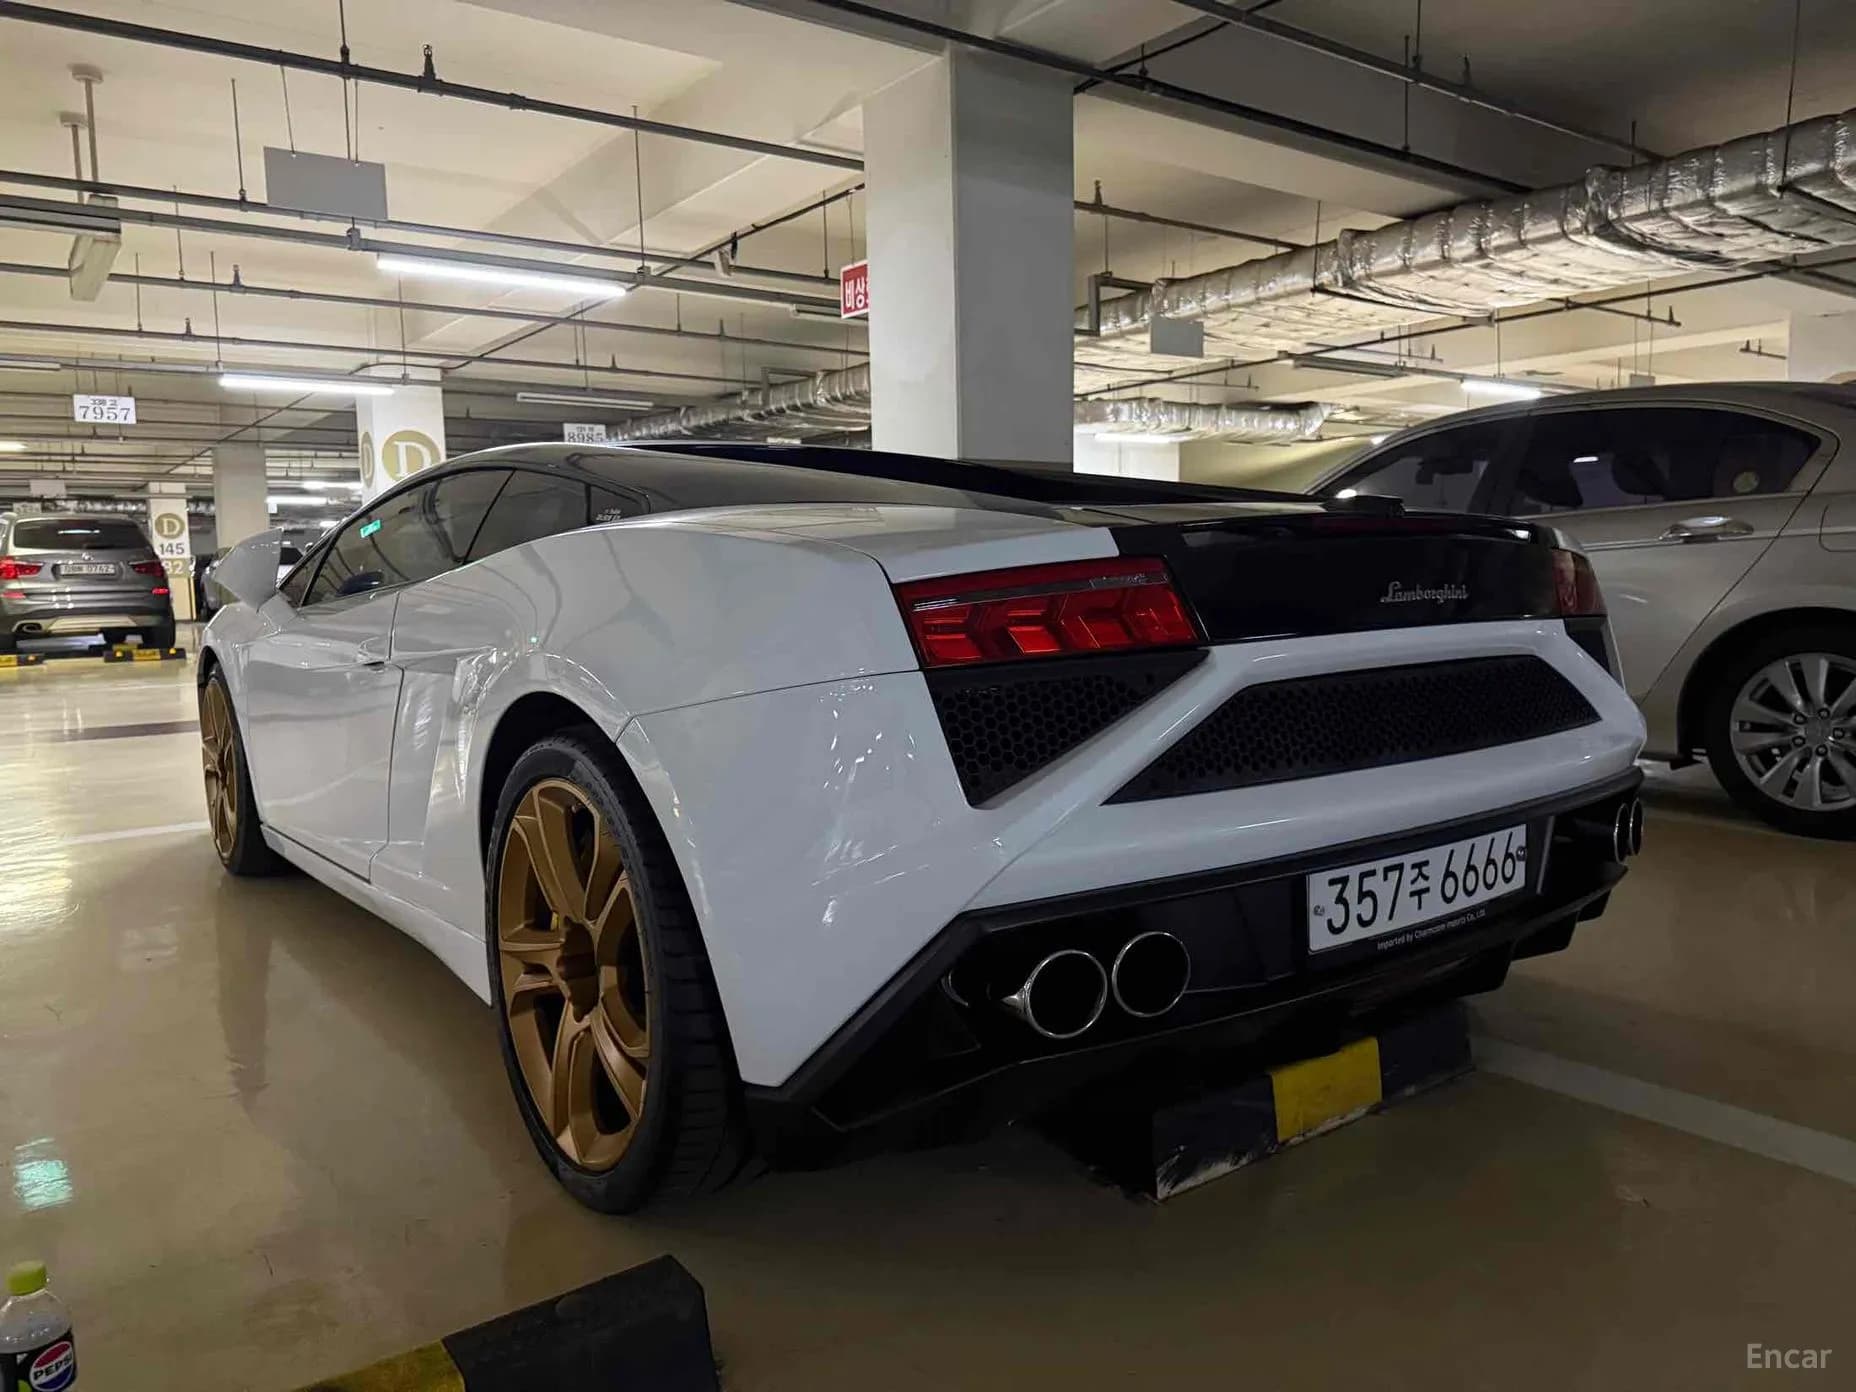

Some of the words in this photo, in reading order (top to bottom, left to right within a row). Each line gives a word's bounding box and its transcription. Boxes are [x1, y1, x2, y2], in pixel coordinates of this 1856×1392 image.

[845, 276, 869, 310] 비상
[79, 405, 131, 421] 7957
[393, 440, 433, 479] D
[161, 517, 181, 536] D
[159, 542, 185, 556] 145
[1380, 580, 1470, 604] Lamborghini
